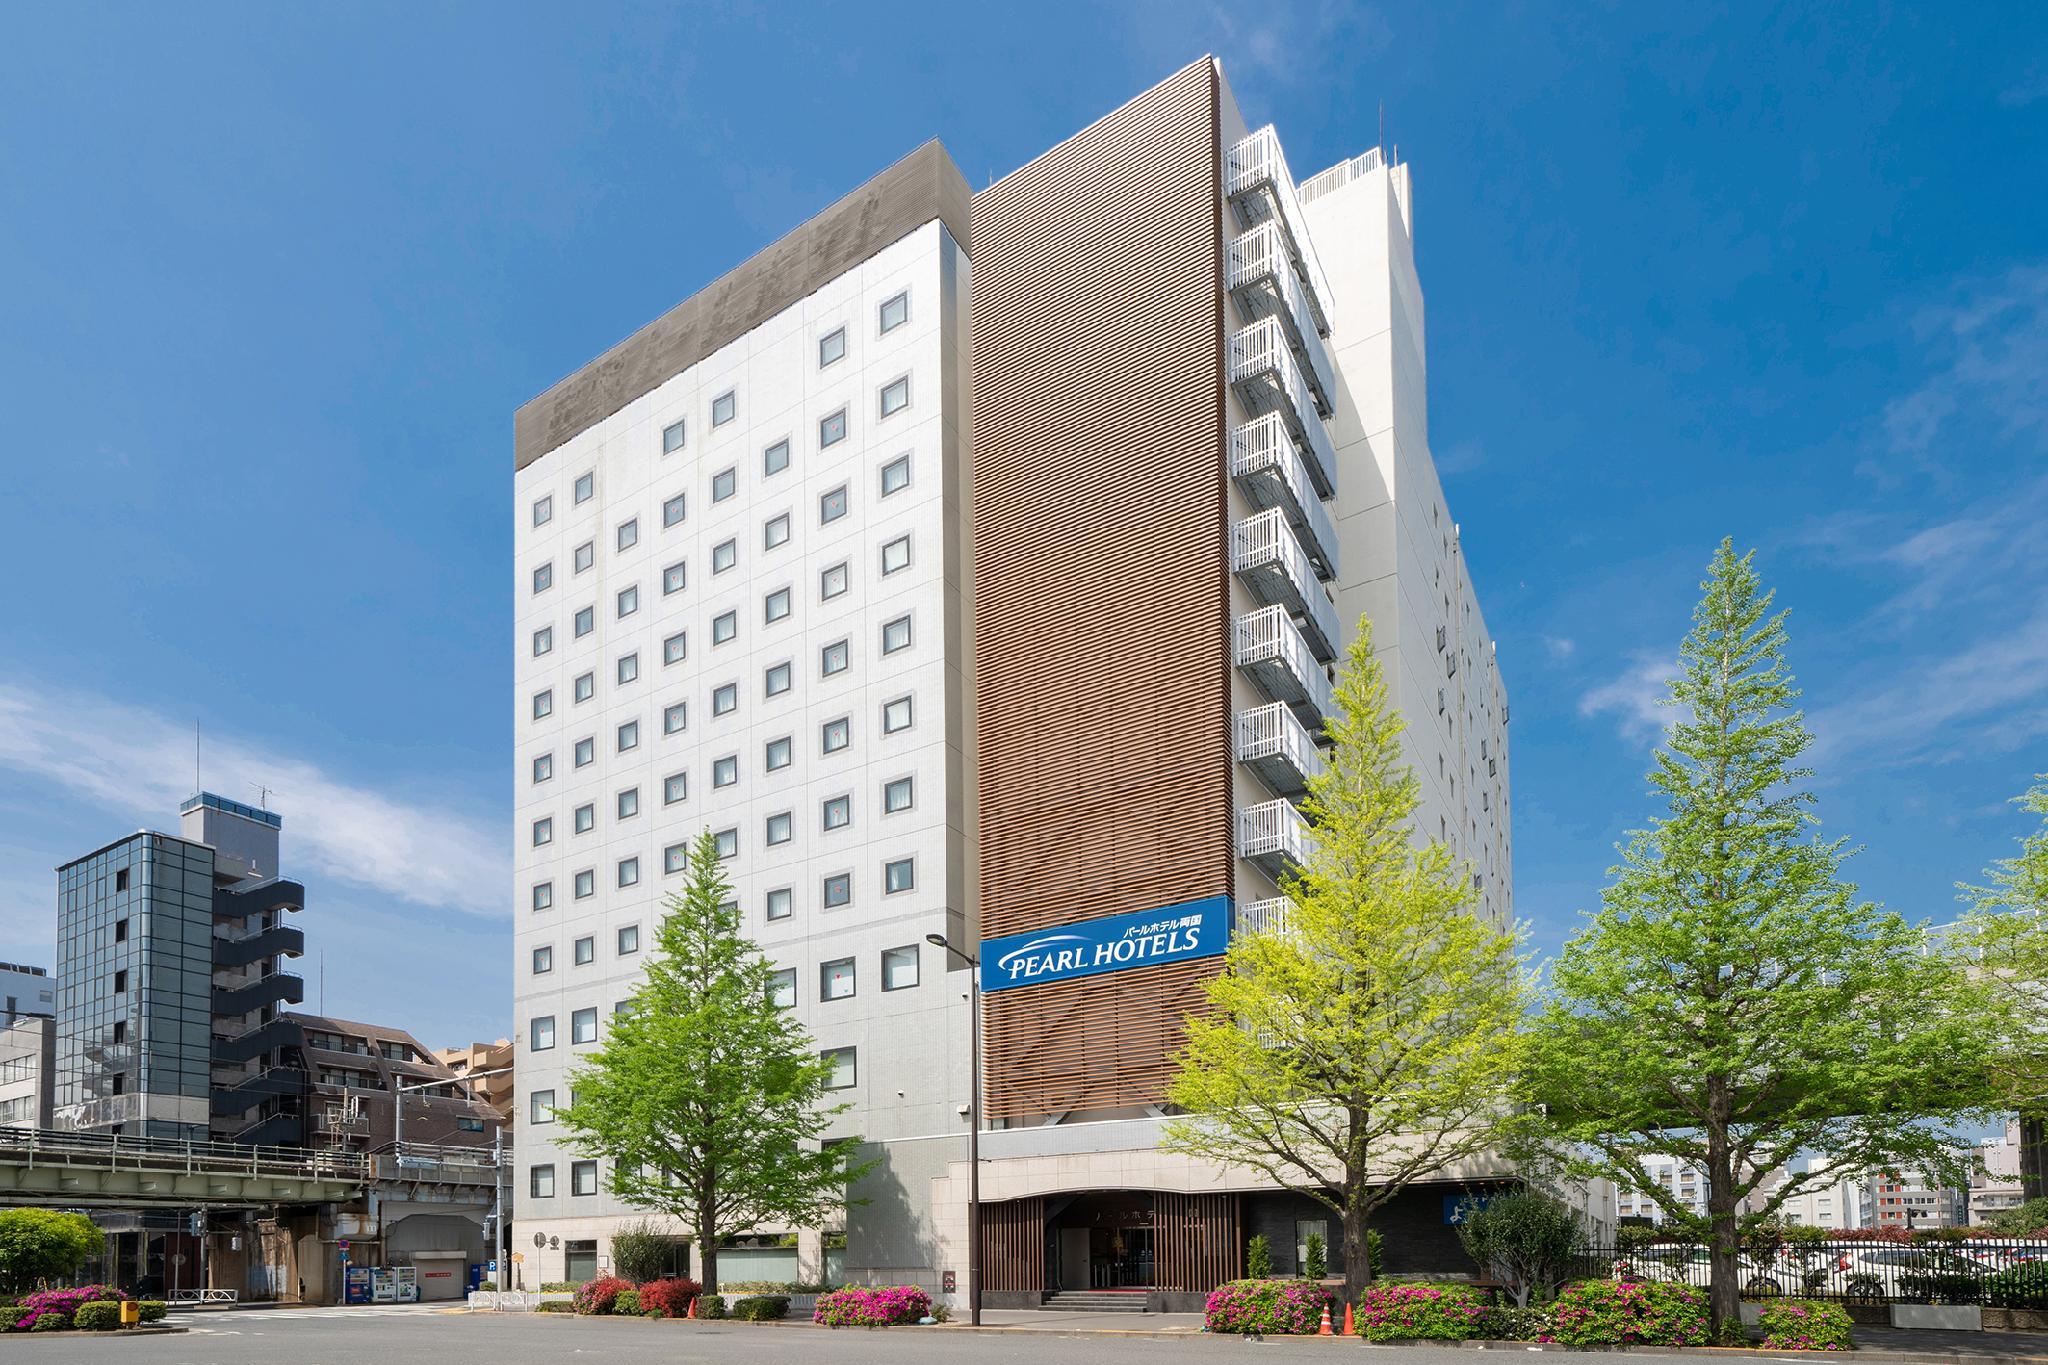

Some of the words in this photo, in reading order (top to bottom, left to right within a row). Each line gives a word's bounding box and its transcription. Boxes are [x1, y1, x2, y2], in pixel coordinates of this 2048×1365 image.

[1123, 914, 1202, 939] パールホテル両国
[1009, 948, 1089, 980] PEARL
[1093, 927, 1201, 966] HOTELS
